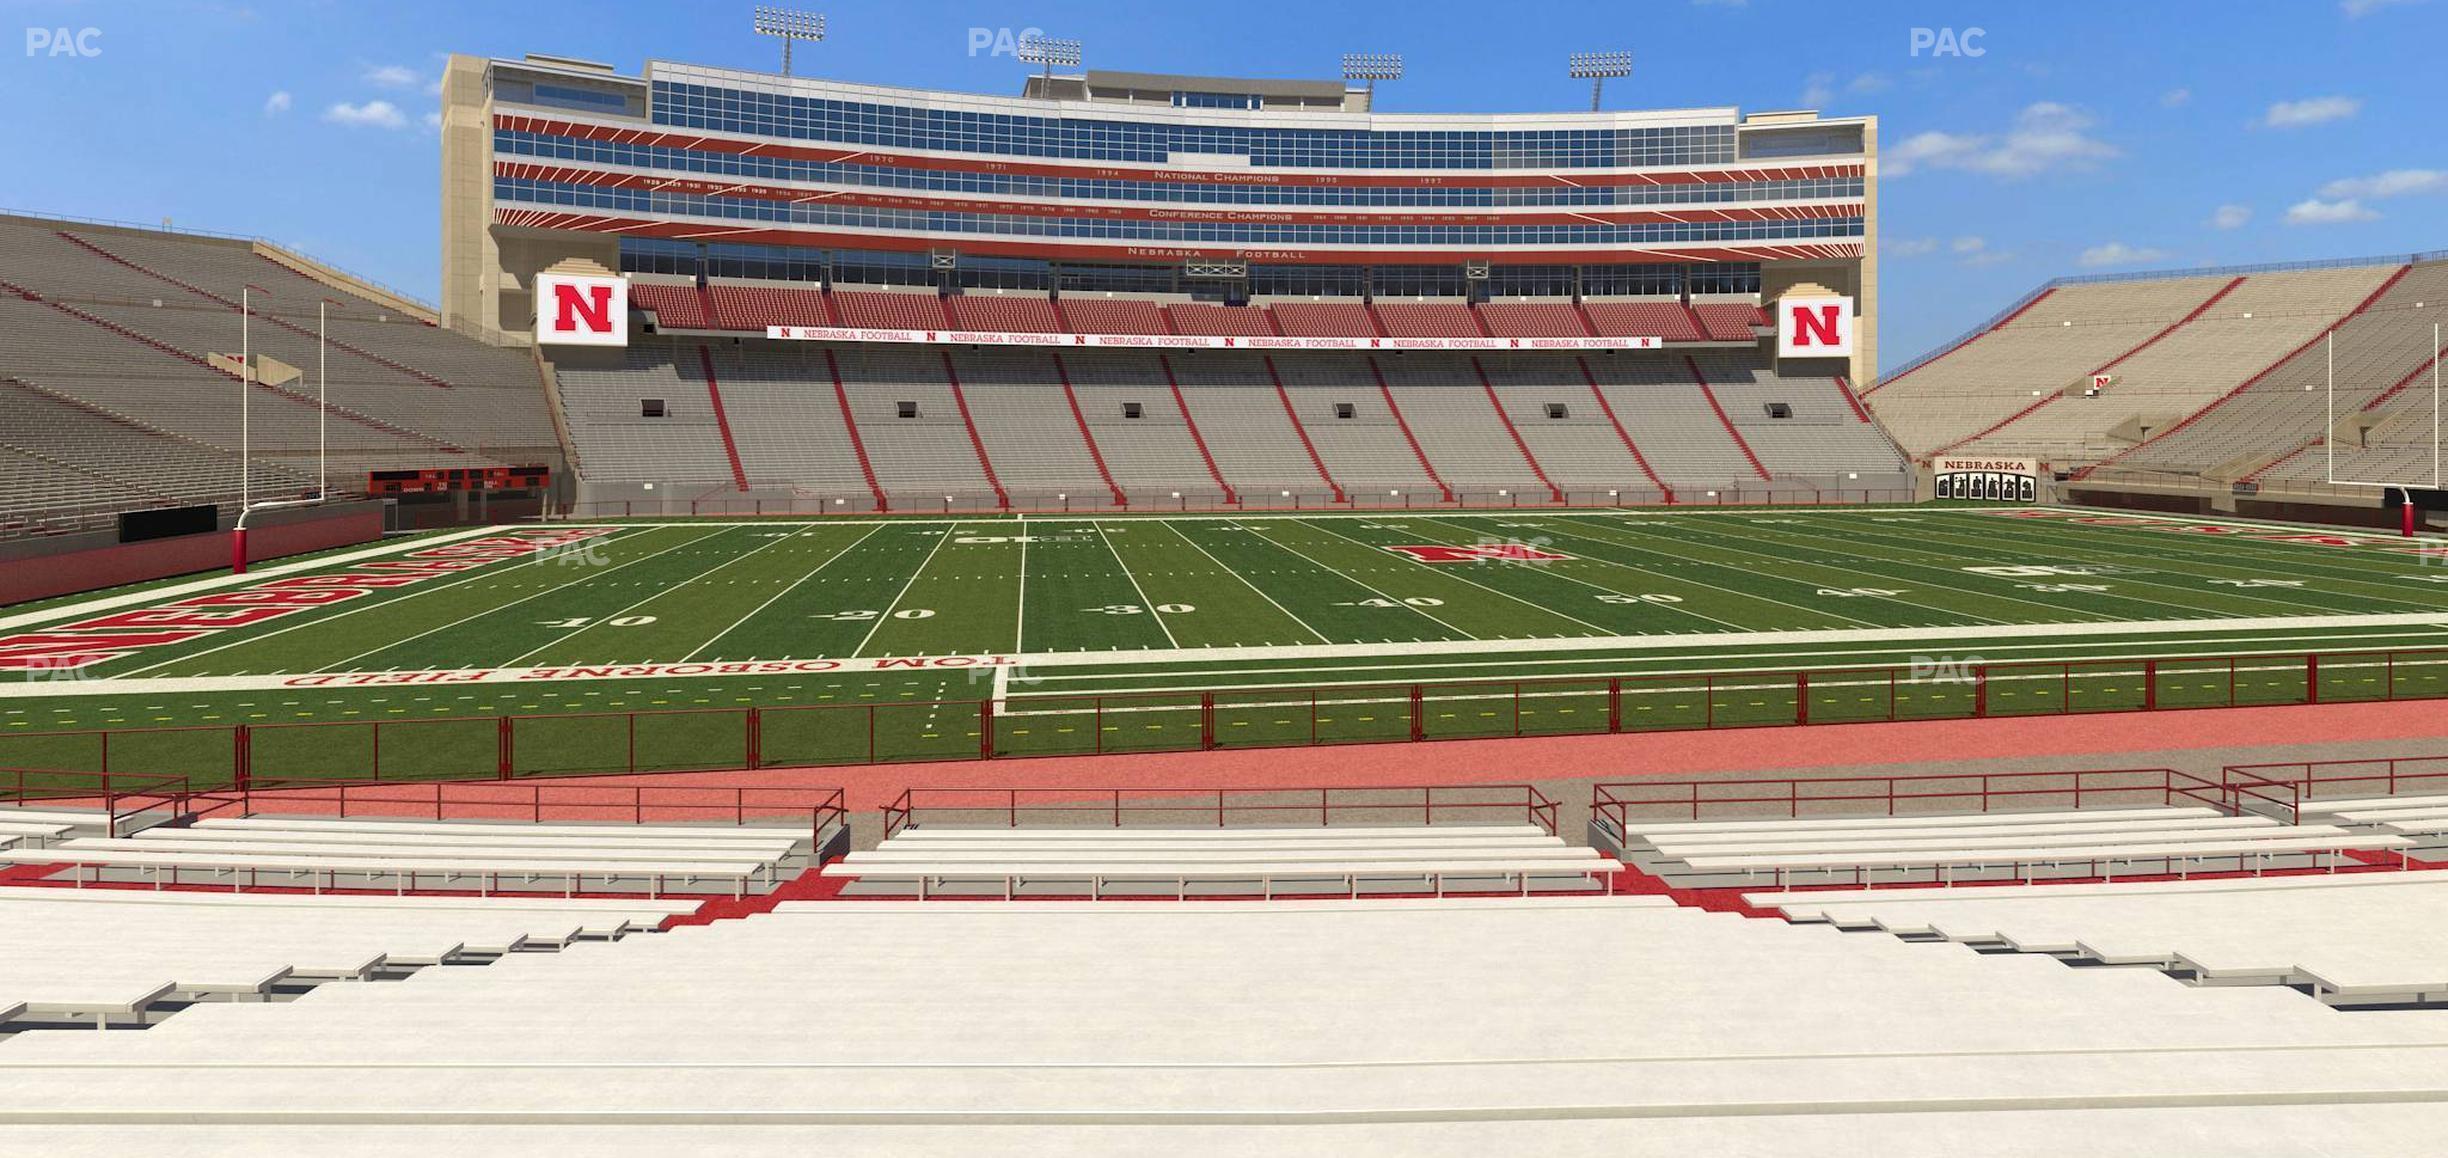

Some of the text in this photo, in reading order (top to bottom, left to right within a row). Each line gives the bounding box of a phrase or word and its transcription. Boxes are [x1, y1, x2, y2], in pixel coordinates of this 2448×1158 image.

[553, 284, 614, 333] N
[1791, 305, 1841, 347] N
[781, 328, 912, 342] N NEBRASKA FOOTBALL
[926, 331, 1060, 345] N NEBRASKA FOOTBALL
[1075, 335, 1210, 347] N NEBRASKA FOOTBALL
[1225, 337, 1357, 348] N NEBRASKA FOOTBALL
[1371, 339, 1497, 348] N NEBRASKA FOOTBALL
[1510, 339, 1629, 348] N NEBRASKA FOOTBALL
[1641, 338, 1650, 347] N
[1944, 461, 2026, 471] NEBRASKA
[521, 660, 842, 680] OSBORNE
[284, 672, 498, 687] FIELD
